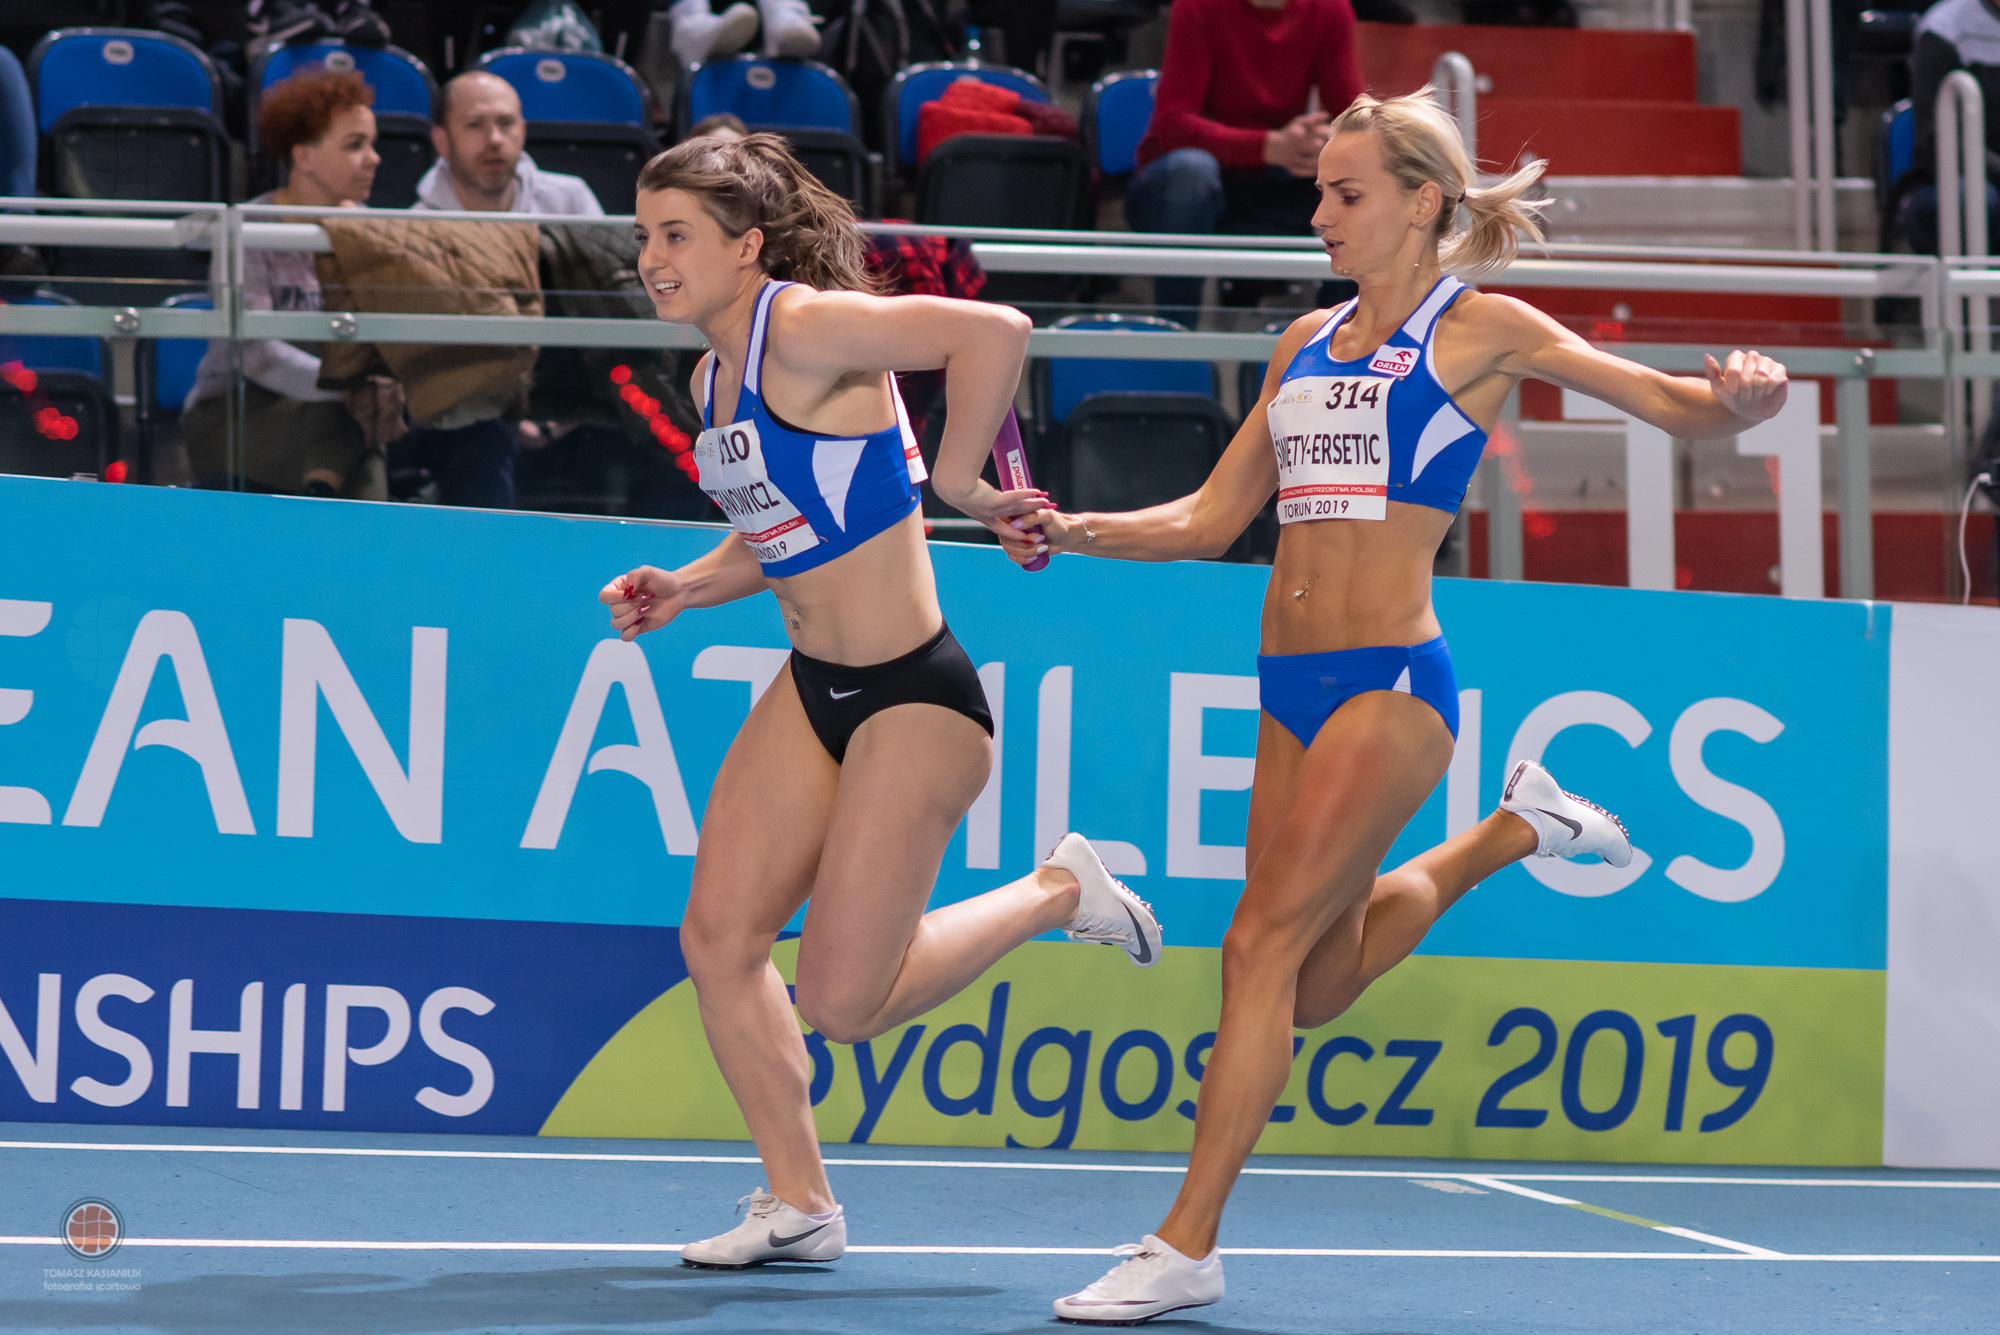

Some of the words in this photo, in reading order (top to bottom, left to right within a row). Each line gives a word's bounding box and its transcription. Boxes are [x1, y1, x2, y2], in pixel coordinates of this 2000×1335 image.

[1376, 361, 1407, 372] ORLEN
[1325, 380, 1382, 410] 314
[1350, 486, 1377, 494] POLSKI
[1283, 496, 1312, 519] TORUŃ
[1314, 499, 1350, 515] 2019
[778, 519, 799, 533] POLSKI
[519, 638, 1786, 902] ALEICS
[0, 973, 496, 1117] NSHIPS
[787, 981, 1443, 1150] ydgoscz
[1475, 1006, 1775, 1133] 2019
